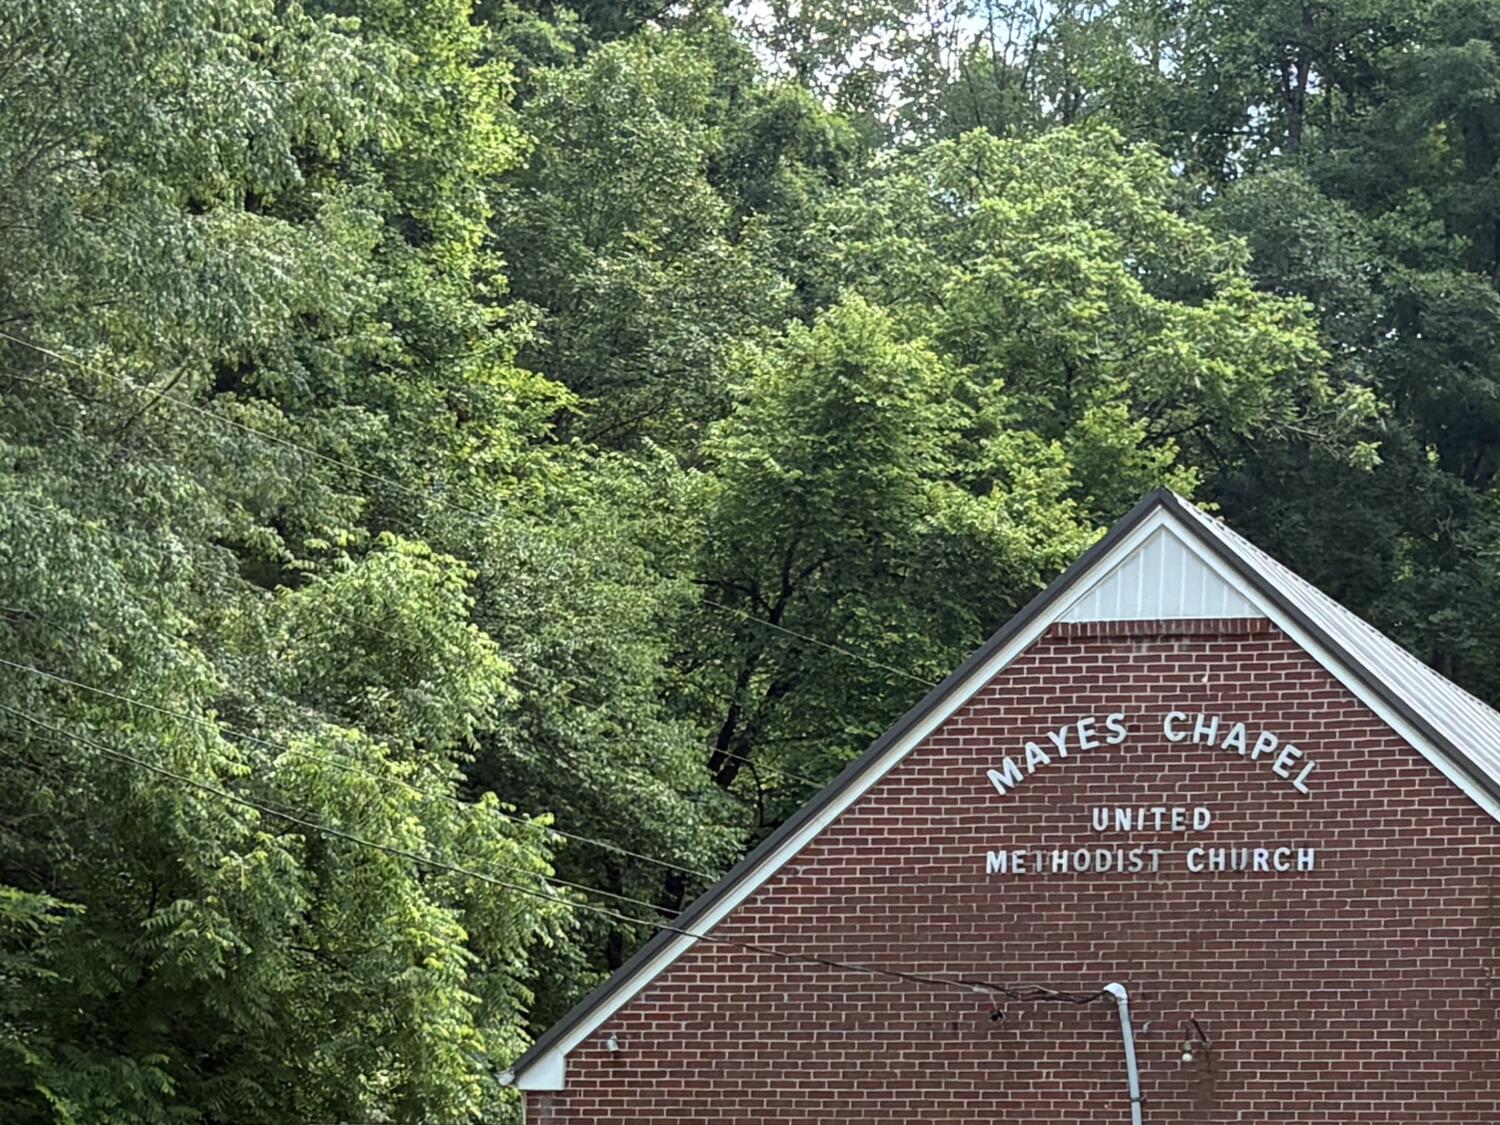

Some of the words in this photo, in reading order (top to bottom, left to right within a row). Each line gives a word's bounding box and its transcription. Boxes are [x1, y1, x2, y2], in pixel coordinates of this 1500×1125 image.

[986, 712, 1128, 796] MAYES
[1163, 710, 1317, 795] CHAPEL
[1092, 807, 1211, 831] UNITED
[985, 848, 1163, 875] METHODIST
[1186, 846, 1316, 873] CHURCH
